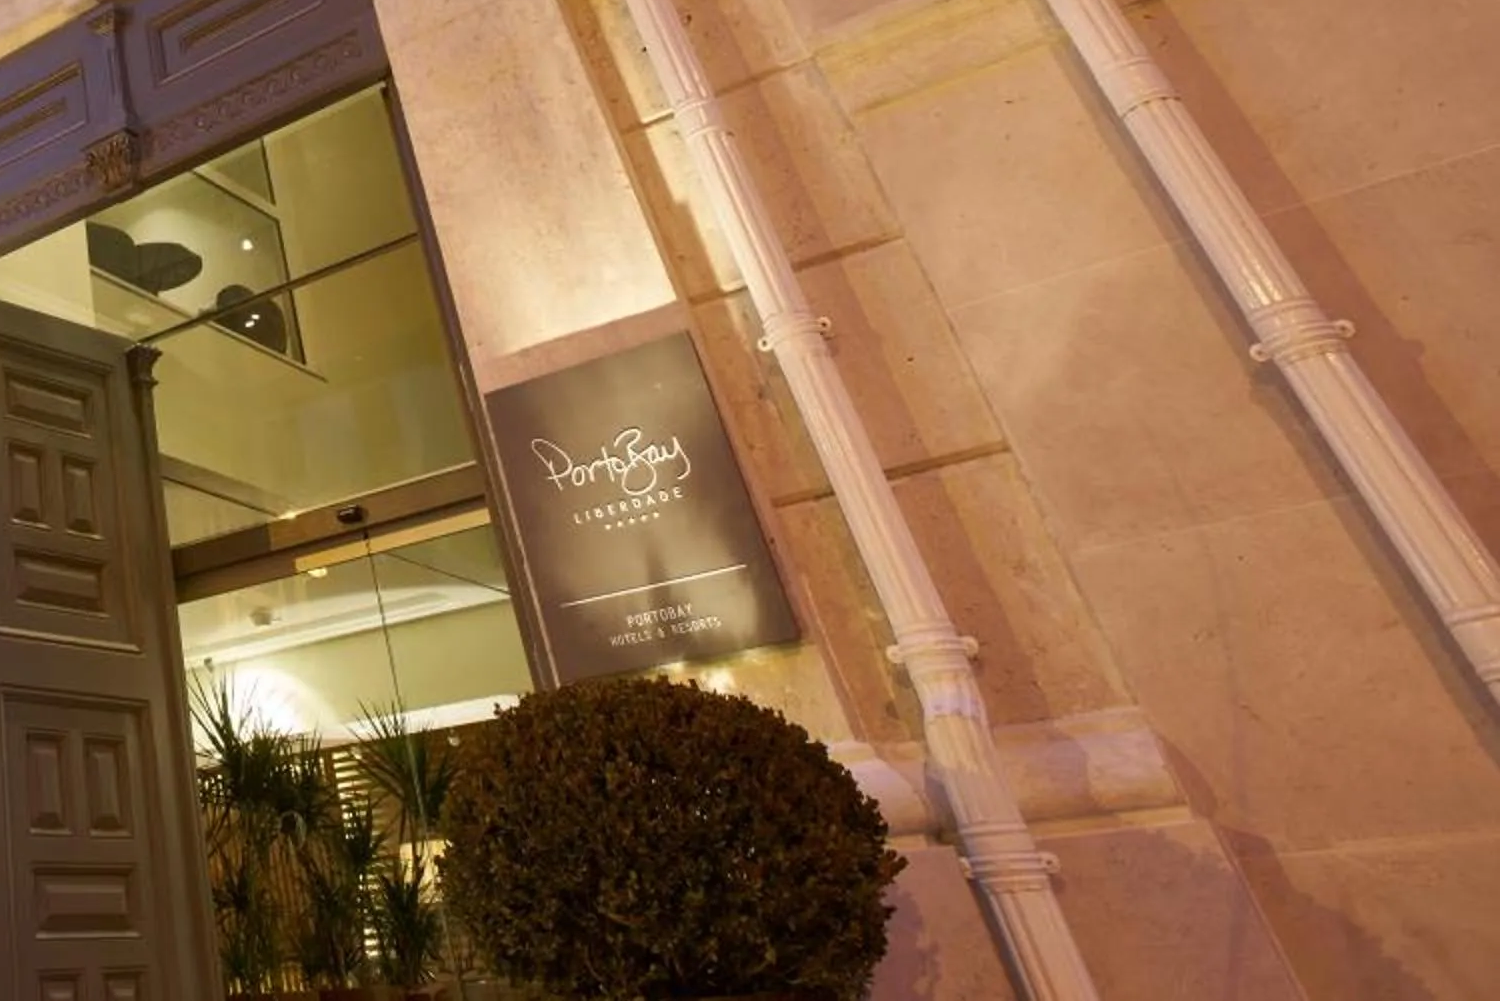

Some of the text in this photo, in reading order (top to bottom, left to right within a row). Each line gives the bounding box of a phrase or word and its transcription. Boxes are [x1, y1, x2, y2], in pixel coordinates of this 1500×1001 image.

[531, 428, 691, 496] PortoBay
[573, 486, 684, 524] LIBERDADE
[626, 602, 693, 628] PORTOBAY
